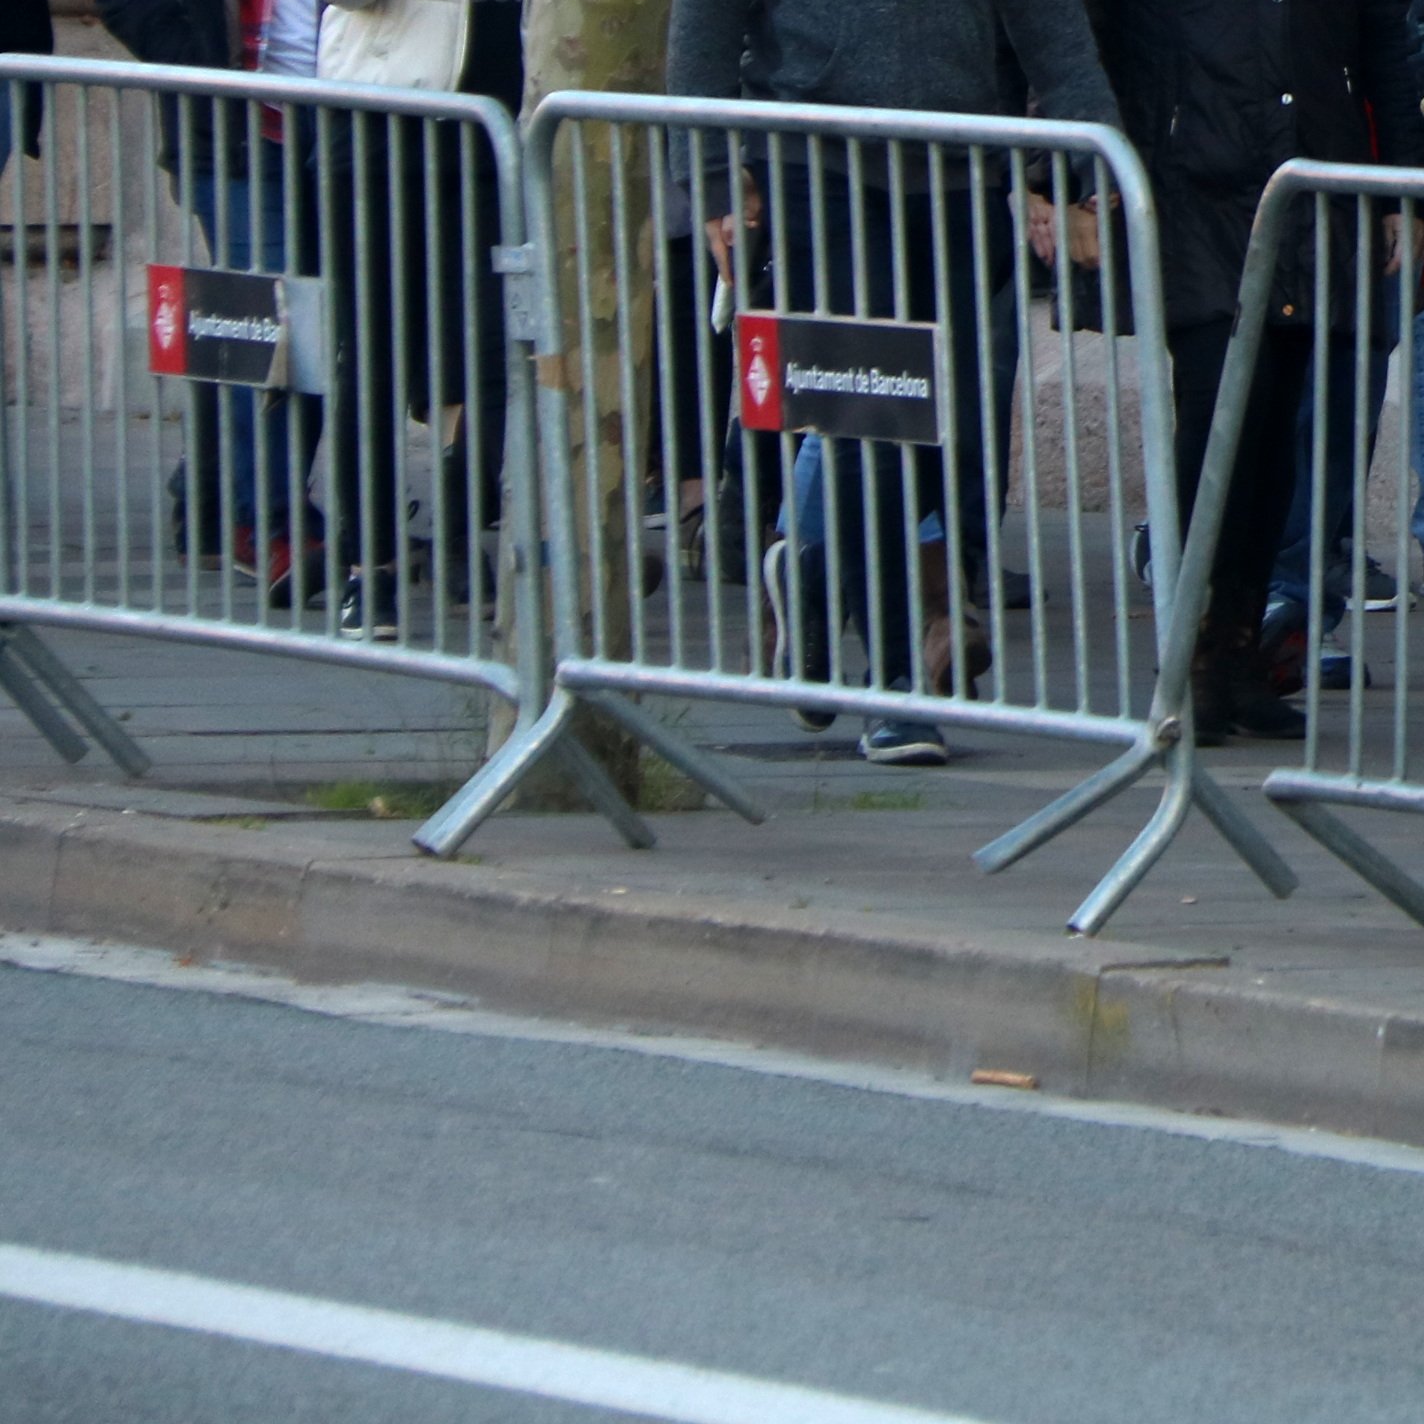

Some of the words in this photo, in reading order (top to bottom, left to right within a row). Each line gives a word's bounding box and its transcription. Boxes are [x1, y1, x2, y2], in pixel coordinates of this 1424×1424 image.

[188, 309, 248, 341] Ajuntament
[250, 316, 262, 341] de
[784, 361, 855, 395] Ajuntament
[856, 367, 869, 394] de
[870, 367, 928, 399] Barcelona
